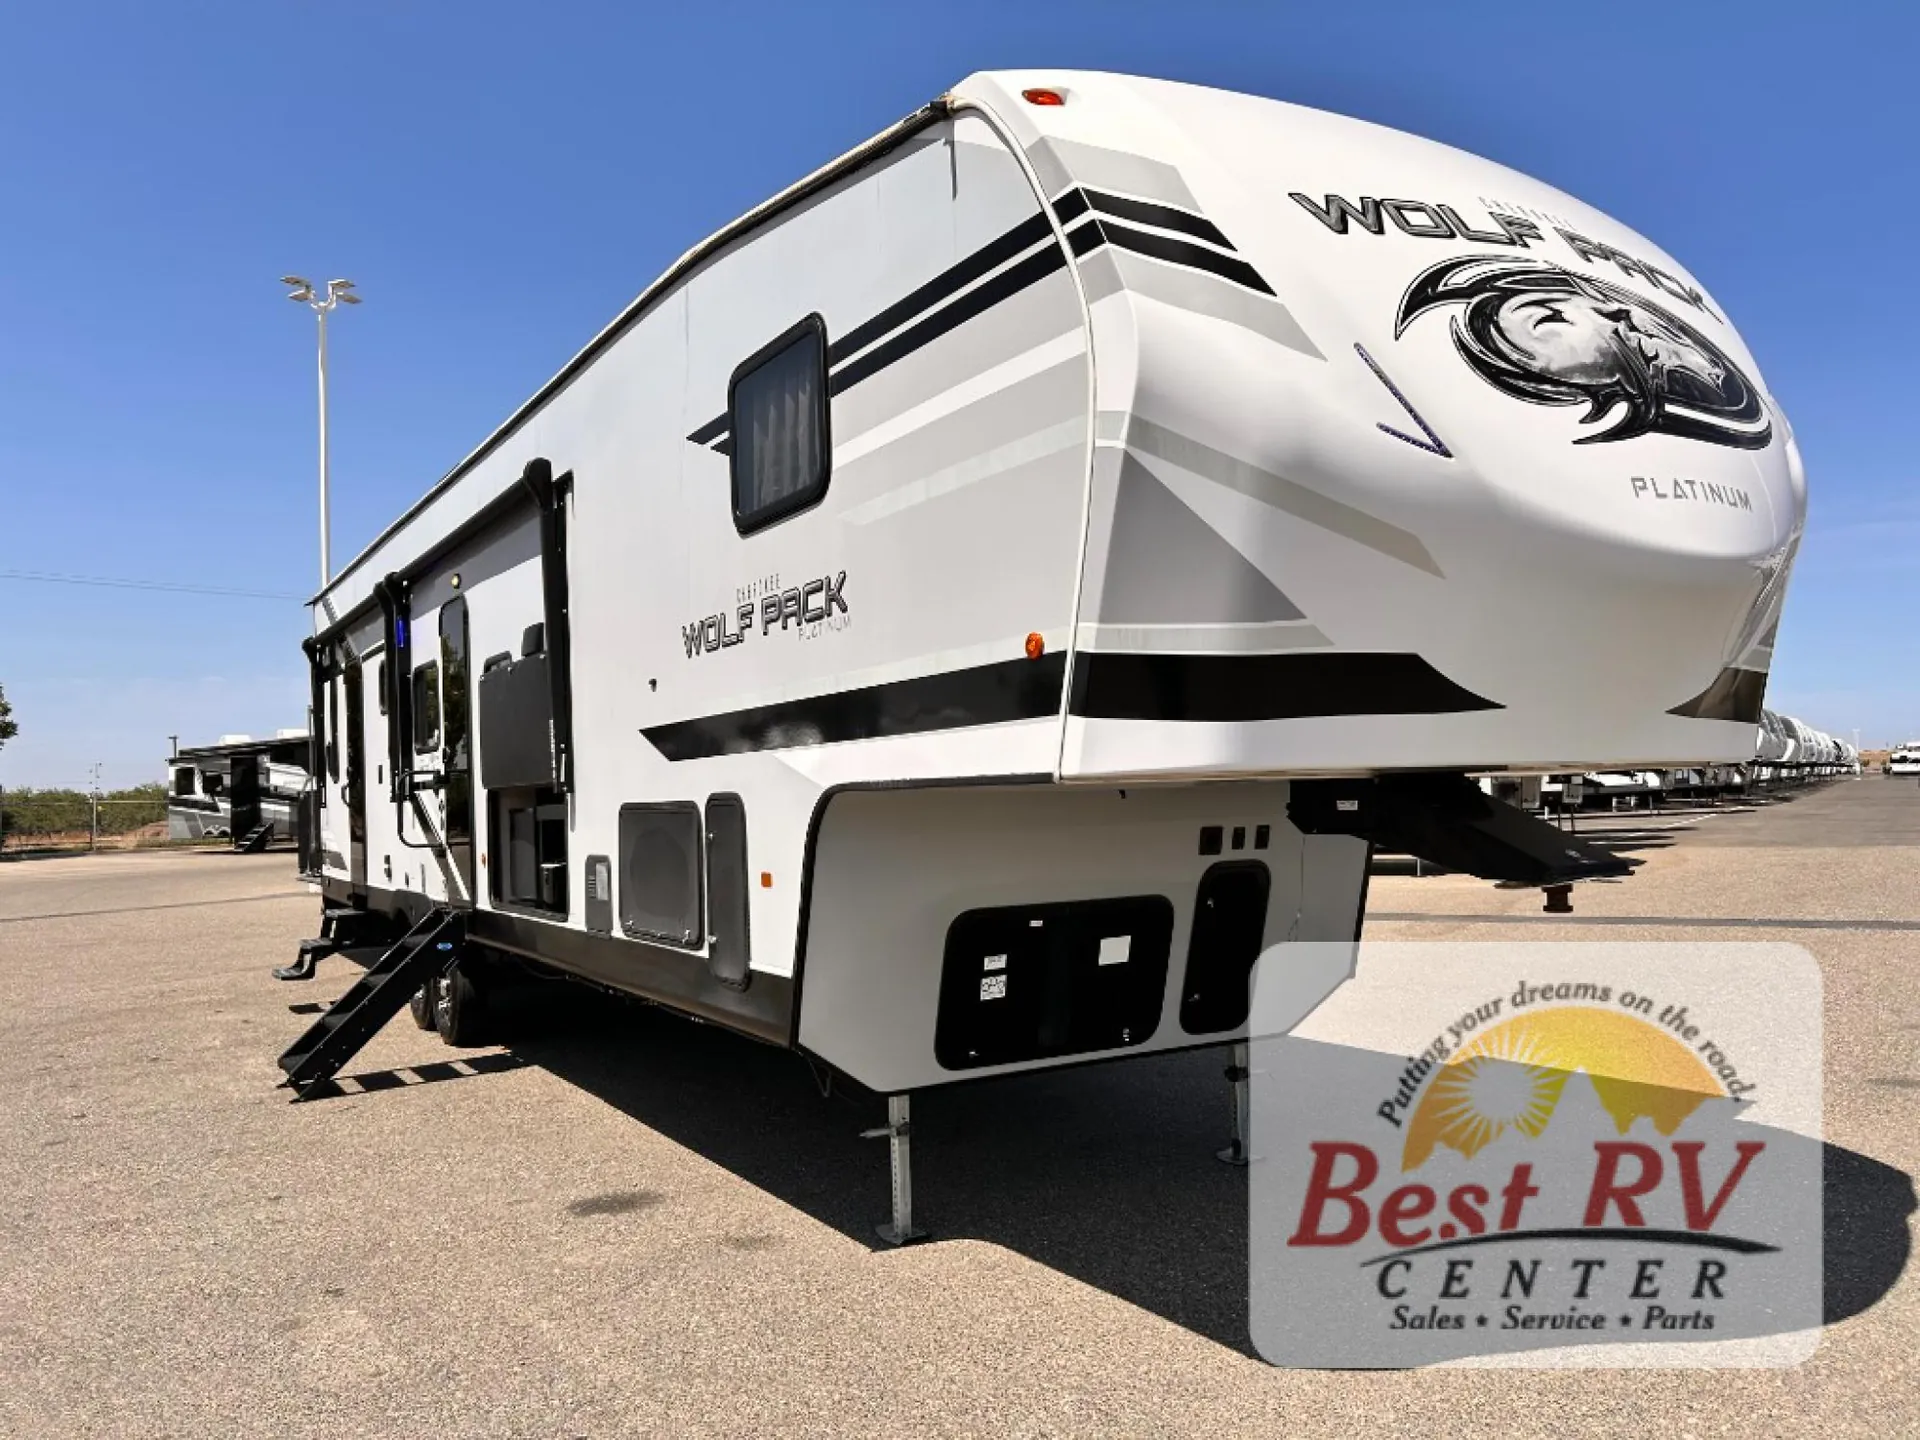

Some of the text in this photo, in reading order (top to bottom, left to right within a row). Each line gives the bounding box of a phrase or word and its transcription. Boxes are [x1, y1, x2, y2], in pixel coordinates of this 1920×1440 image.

[1288, 191, 1545, 249] WOLF
[1631, 475, 1753, 512] PLATINUM
[682, 570, 848, 659] WOLF PACK
